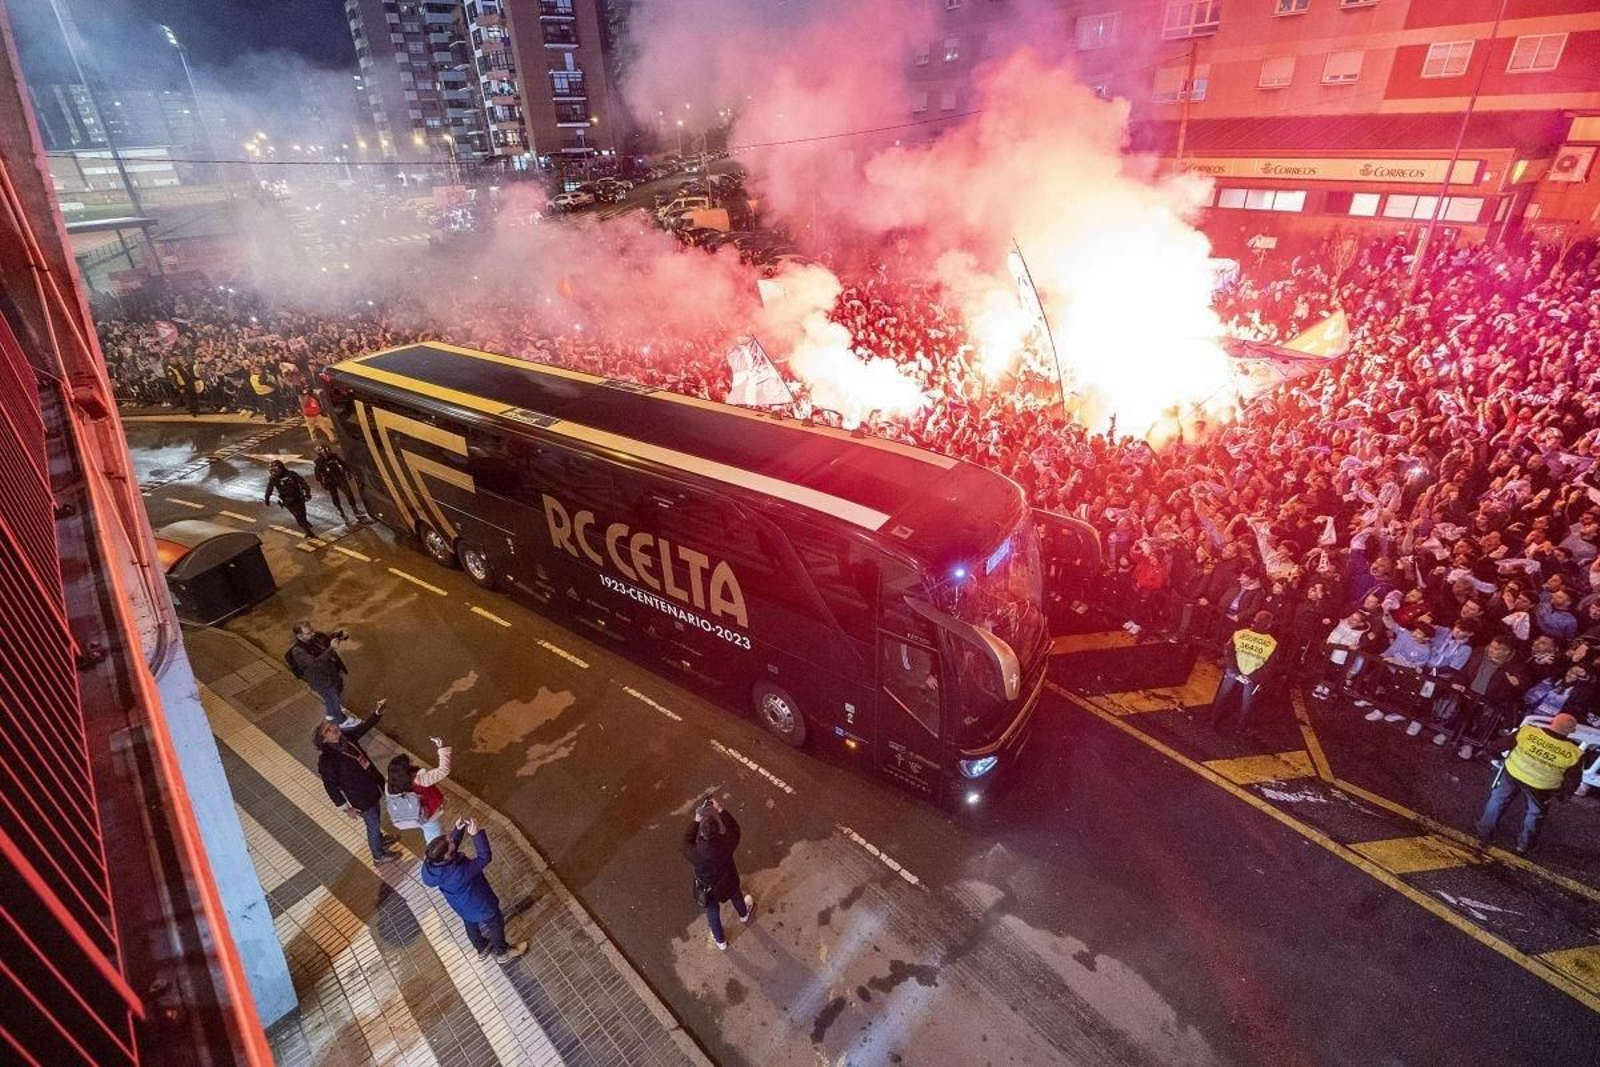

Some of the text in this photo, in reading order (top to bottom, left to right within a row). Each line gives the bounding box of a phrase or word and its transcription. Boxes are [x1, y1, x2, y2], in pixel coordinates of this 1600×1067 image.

[1273, 165, 1317, 175] CORREOS
[1374, 167, 1426, 178] CORREOS
[542, 493, 748, 629] RC CELTA
[1527, 734, 1572, 759] SEGURIDAD
[1528, 744, 1557, 762] 3652
